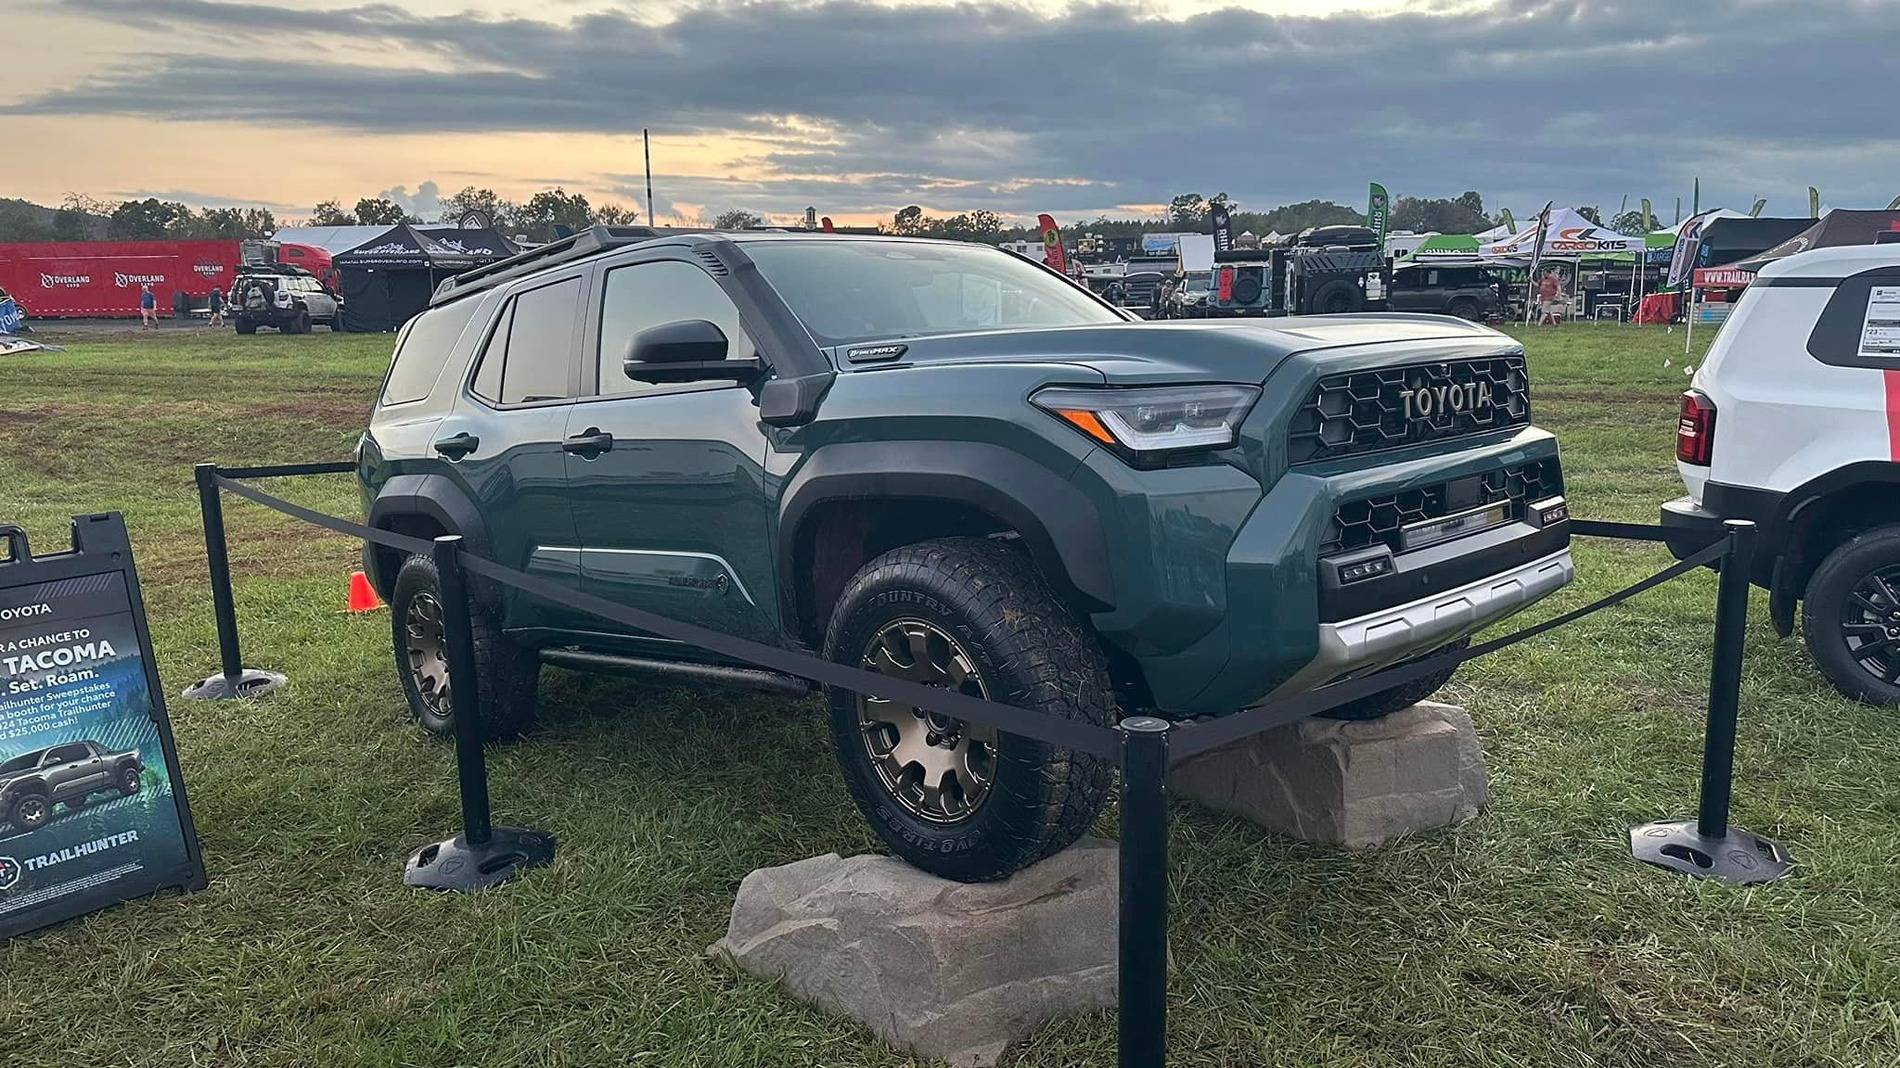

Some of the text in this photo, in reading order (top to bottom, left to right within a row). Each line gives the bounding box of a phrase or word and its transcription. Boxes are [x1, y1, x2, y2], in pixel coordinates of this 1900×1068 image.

[54, 275, 90, 284] OVERLAND
[128, 274, 165, 283] OVERLAND
[1399, 381, 1491, 419] TOYOTA
[7, 641, 17, 652] A
[18, 631, 71, 649] CHANCE
[72, 628, 90, 640] TO
[3, 640, 116, 675] TACOMA
[9, 669, 99, 694] Set. Roam.
[46, 682, 111, 701] Sweepstakes
[6, 706, 38, 719] booth
[40, 703, 55, 712] for
[56, 697, 79, 710] your
[81, 690, 116, 703] chance
[18, 713, 57, 726] Tacoma
[58, 700, 112, 718] Trailhunter
[8, 722, 50, 738] $25,000
[51, 717, 78, 729] cash!
[24, 830, 139, 871] TRAILHUNTER
